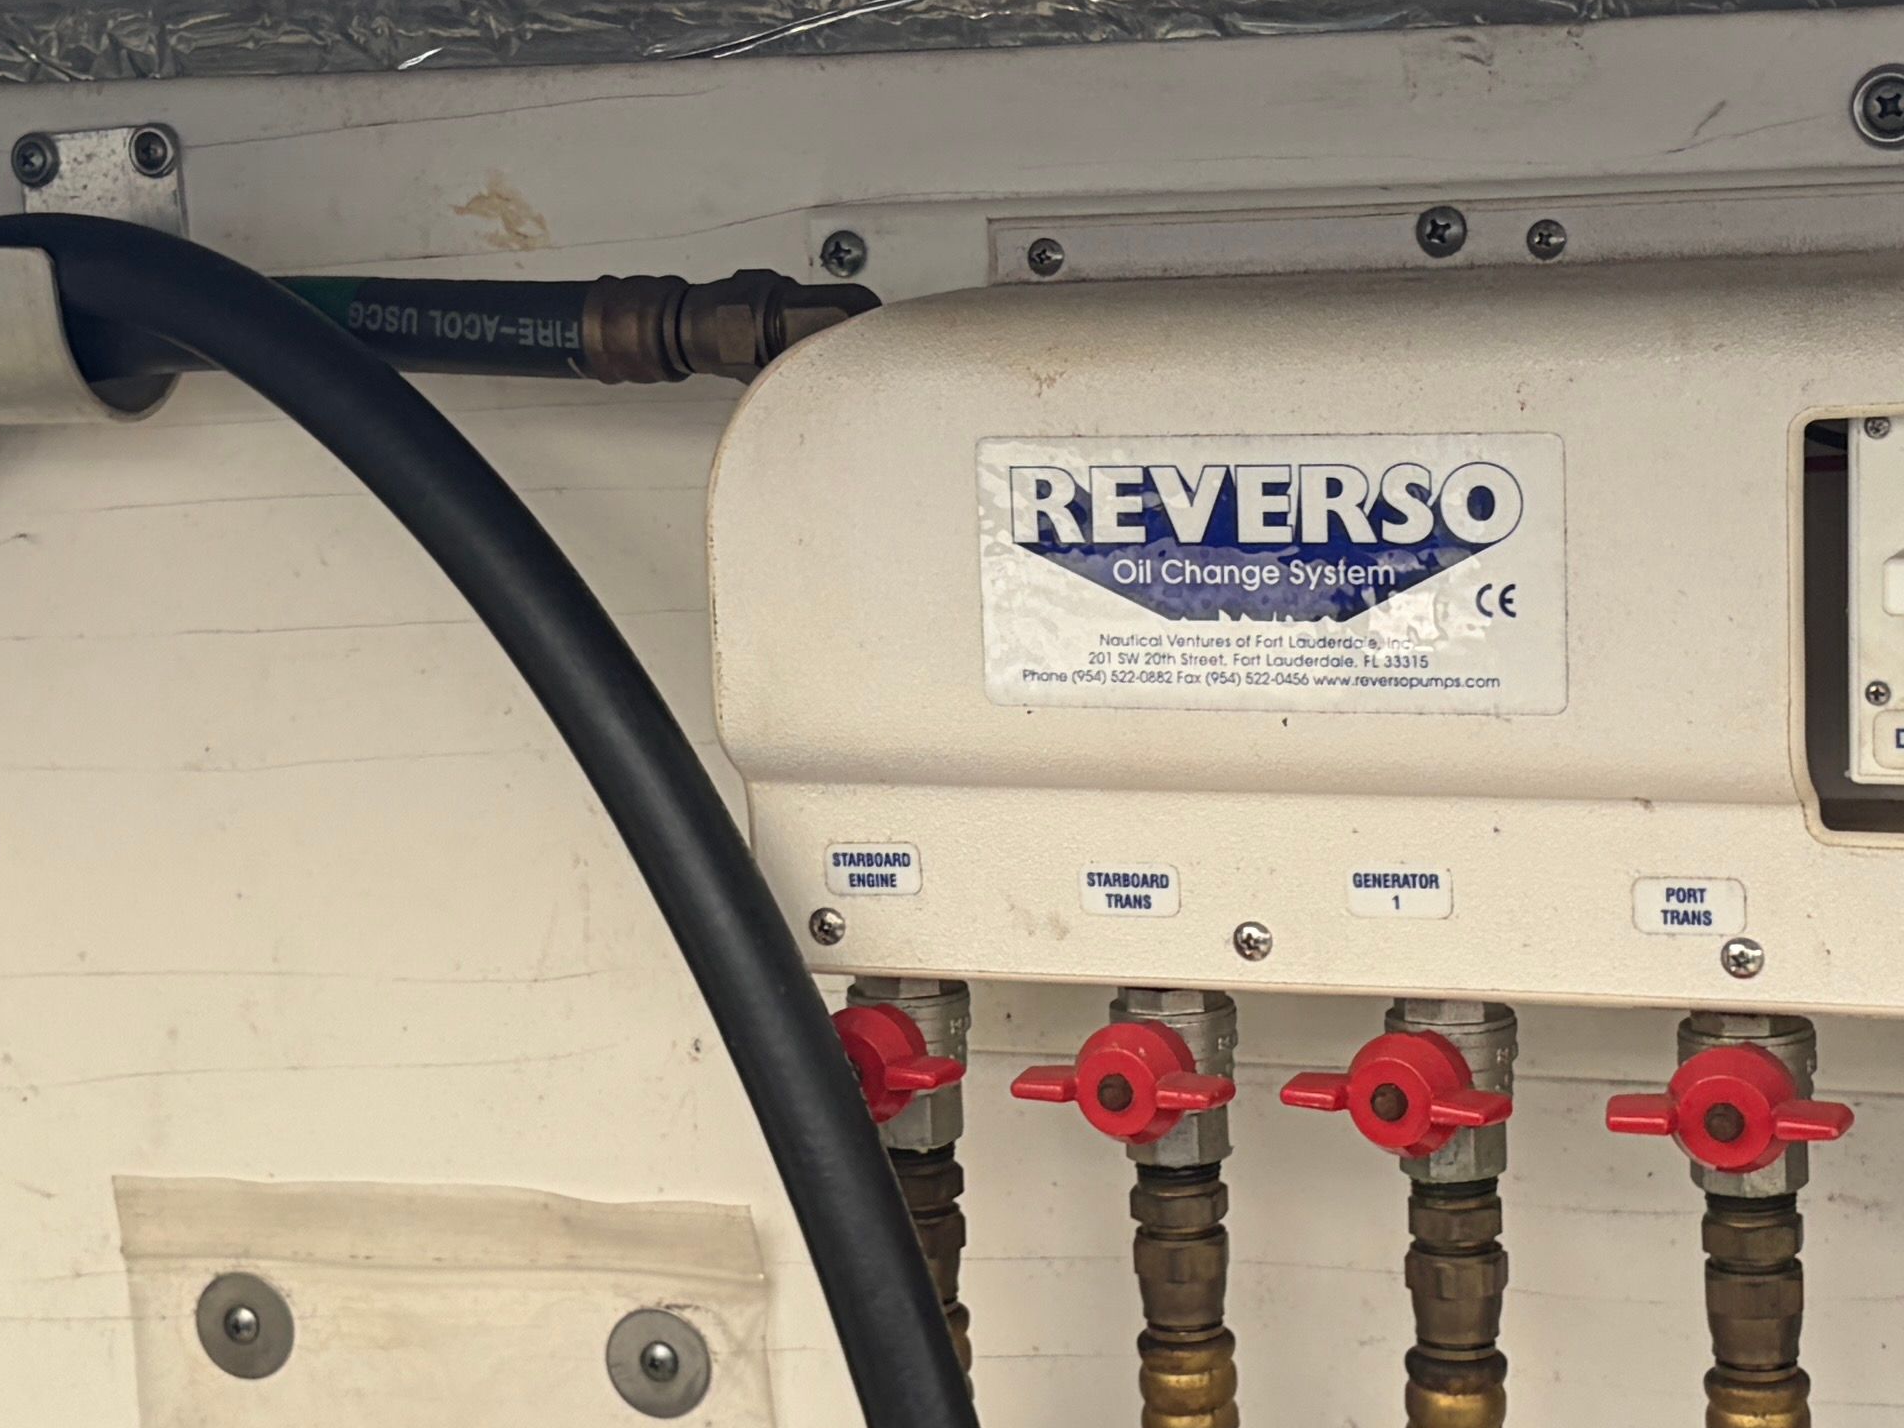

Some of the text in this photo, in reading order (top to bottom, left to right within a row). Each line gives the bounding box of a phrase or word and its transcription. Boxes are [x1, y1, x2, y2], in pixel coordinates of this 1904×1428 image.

[348, 301, 580, 348] FIRE-ACOL USCG
[1008, 461, 1523, 544] REVERSO
[1112, 557, 1395, 591] Oil Change System
[1099, 633, 1162, 647] Nautical
[1166, 634, 1231, 648] Ventures
[1236, 634, 1251, 648] of
[1256, 635, 1283, 649] Fort
[1088, 652, 1112, 665] 201
[1118, 652, 1140, 665] SW
[1145, 652, 1176, 665] 20th
[1233, 654, 1261, 666] Fort
[1364, 655, 1380, 668] FL
[1384, 655, 1430, 669] 33315
[1022, 669, 1501, 691] Phone (954) 522-0882 Fax (954) 522-0456 www.reversopumps.com
[831, 851, 912, 870] STARBOARD
[847, 872, 898, 890] ENGINE
[1085, 870, 1171, 890] STARBOARD
[1352, 872, 1441, 891] GENERATOR
[1104, 892, 1153, 911] TRANS
[1391, 894, 1401, 911] 1
[1664, 885, 1707, 904] PORT
[1660, 907, 1713, 927] TRANS
